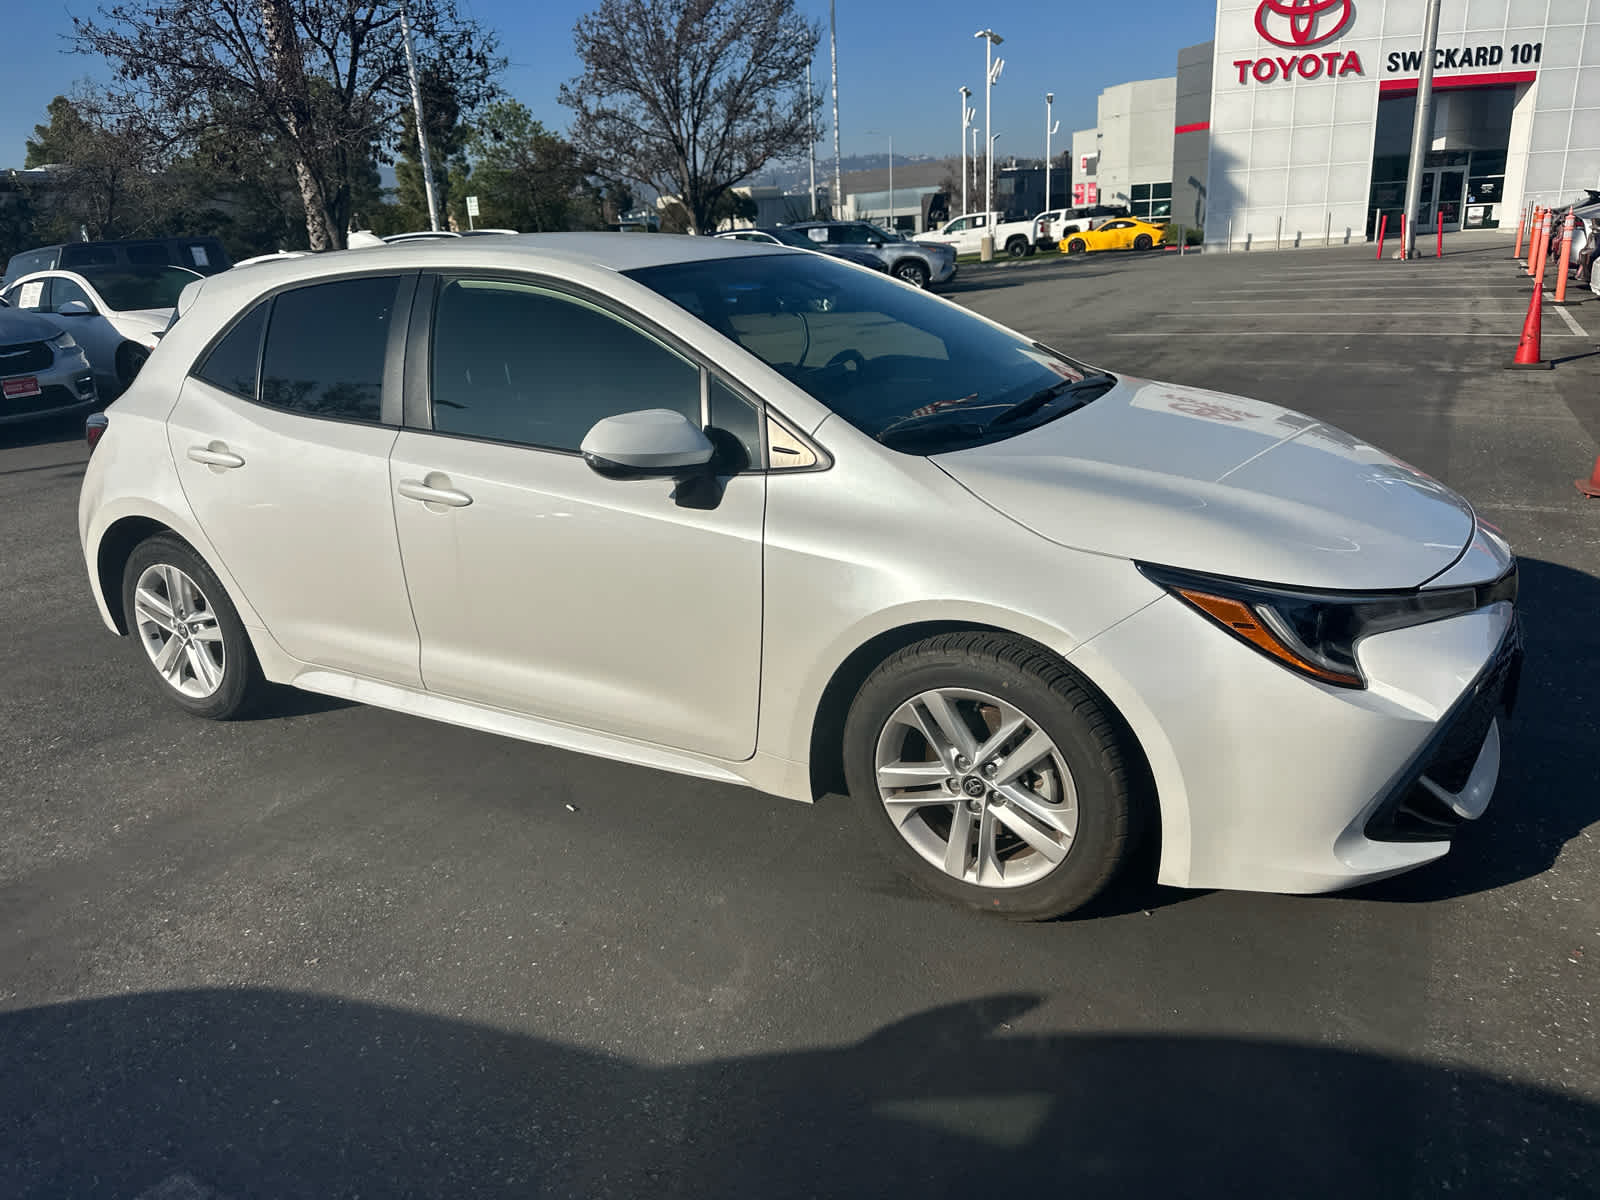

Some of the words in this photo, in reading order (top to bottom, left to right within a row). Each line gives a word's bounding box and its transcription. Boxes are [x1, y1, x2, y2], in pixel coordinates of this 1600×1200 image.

[1233, 50, 1362, 83] TOYOTA
[1387, 45, 1503, 72] SWCKARD
[1510, 43, 1542, 64] 101
